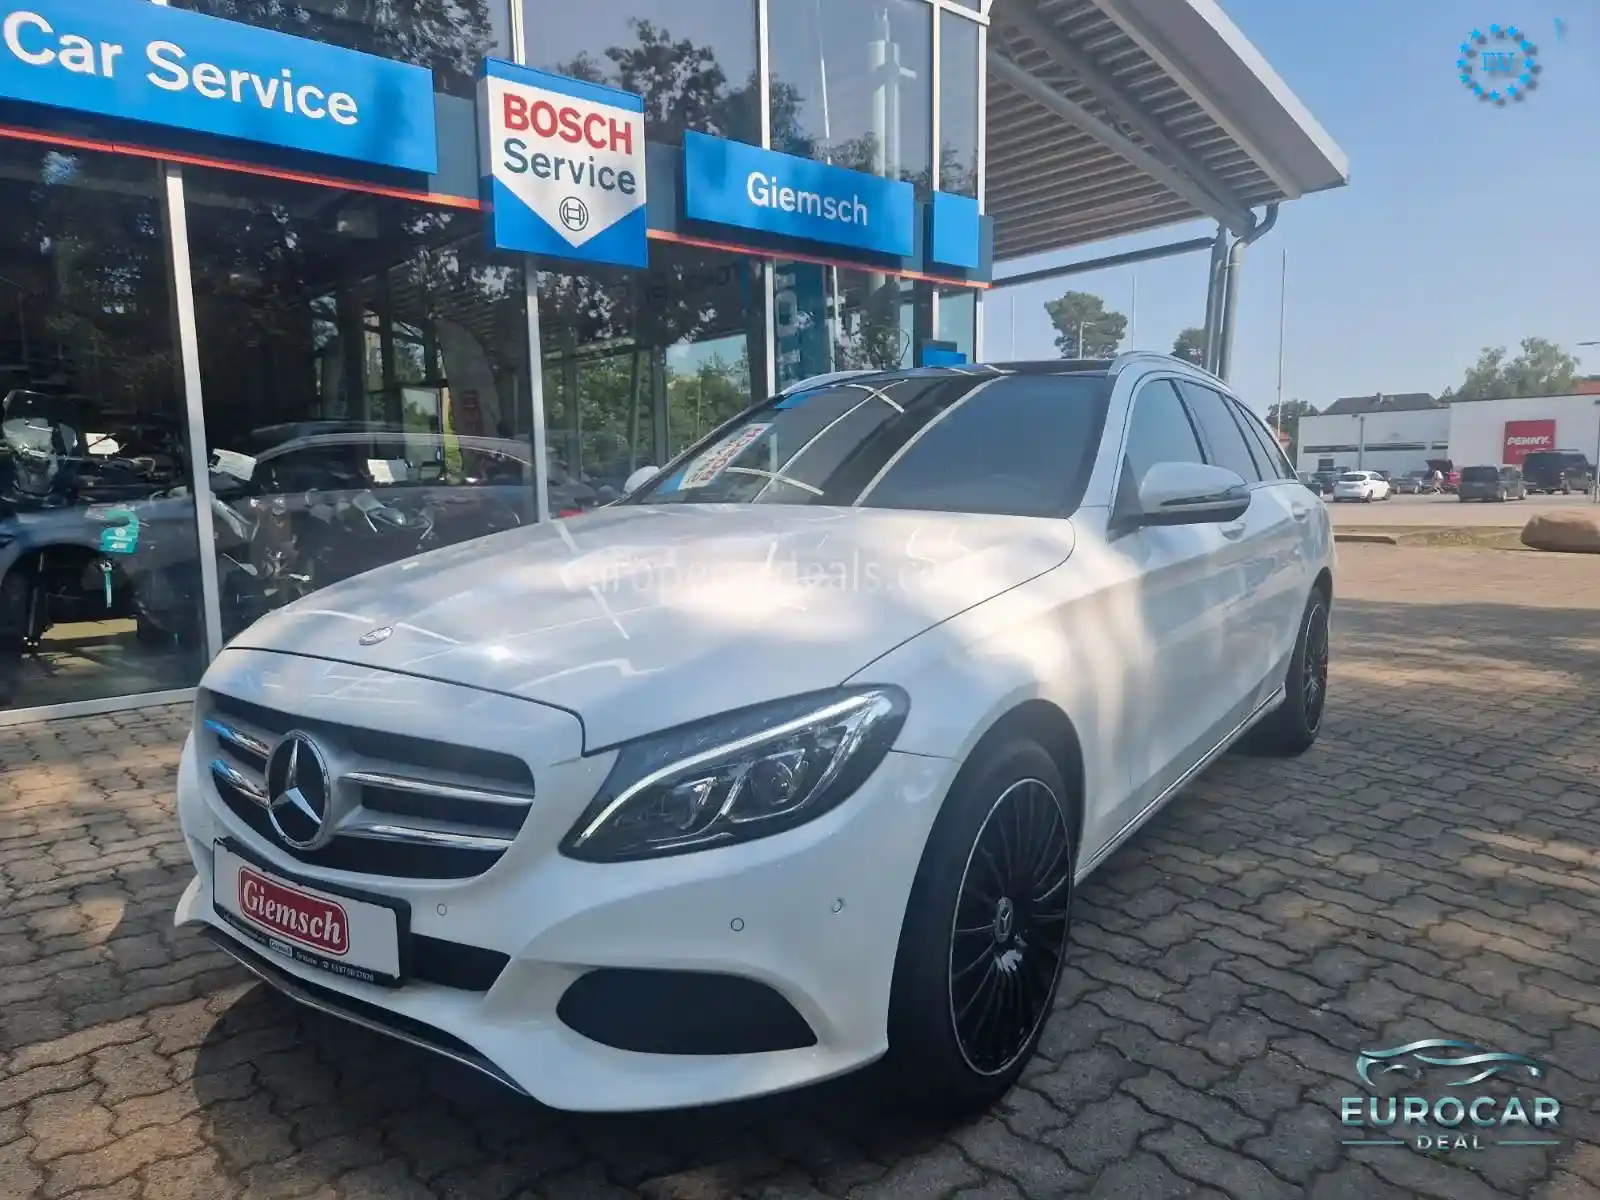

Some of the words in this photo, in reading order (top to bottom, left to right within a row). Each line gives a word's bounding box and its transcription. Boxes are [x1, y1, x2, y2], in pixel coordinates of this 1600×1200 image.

[3, 11, 123, 78] Car
[146, 40, 359, 125] Service
[503, 92, 633, 155] BOSCH
[503, 137, 636, 195] Service
[746, 171, 868, 226] Giemsch
[243, 880, 342, 944] Giemsch
